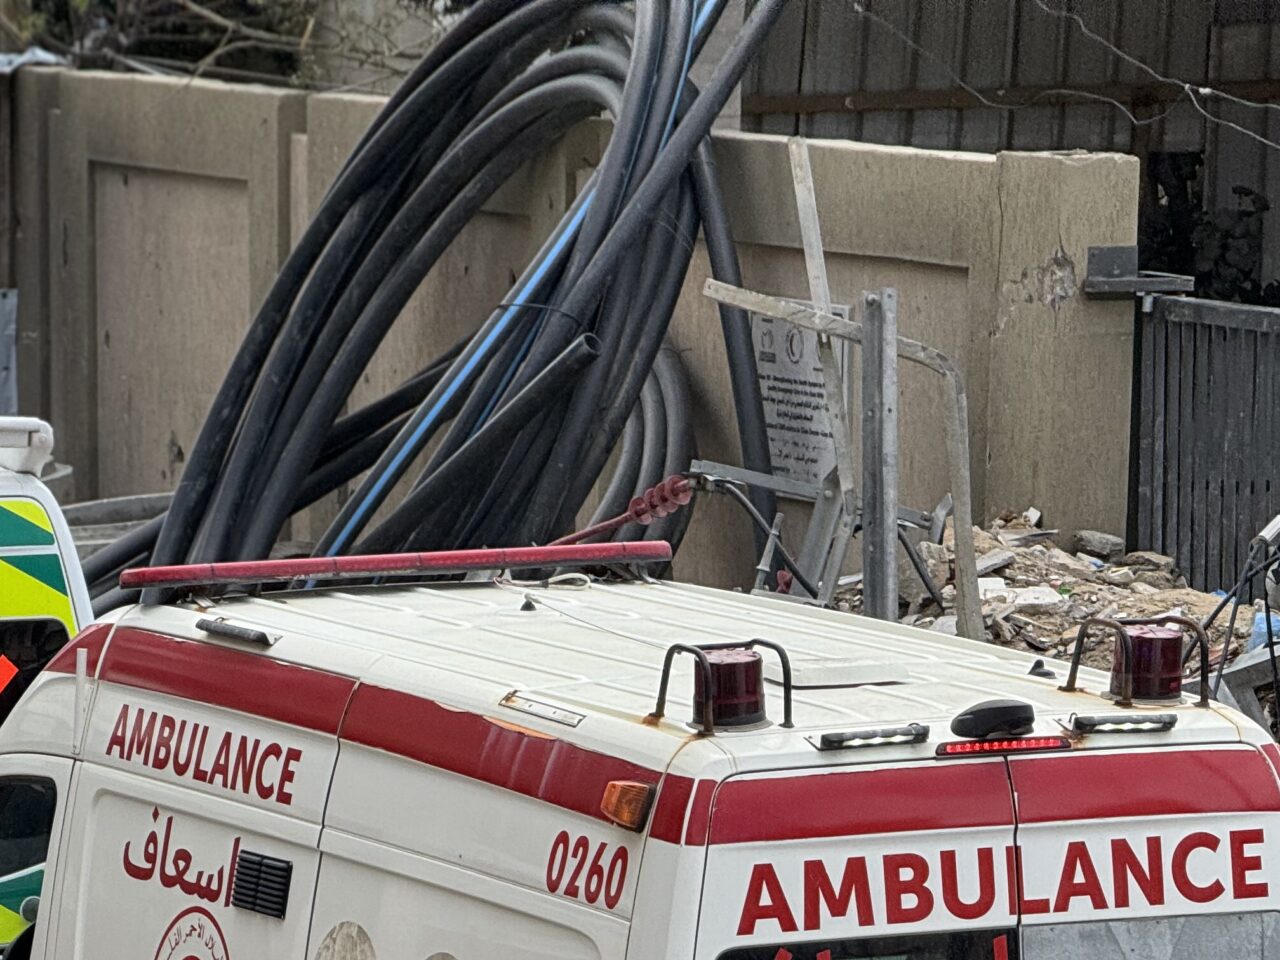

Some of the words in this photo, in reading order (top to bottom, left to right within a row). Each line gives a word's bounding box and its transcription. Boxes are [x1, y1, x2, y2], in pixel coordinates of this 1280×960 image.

[105, 704, 303, 806] AMBULANCE
[122, 805, 242, 908] اسعاف
[546, 829, 629, 910] 0260
[736, 828, 1270, 937] AMBULANCE
